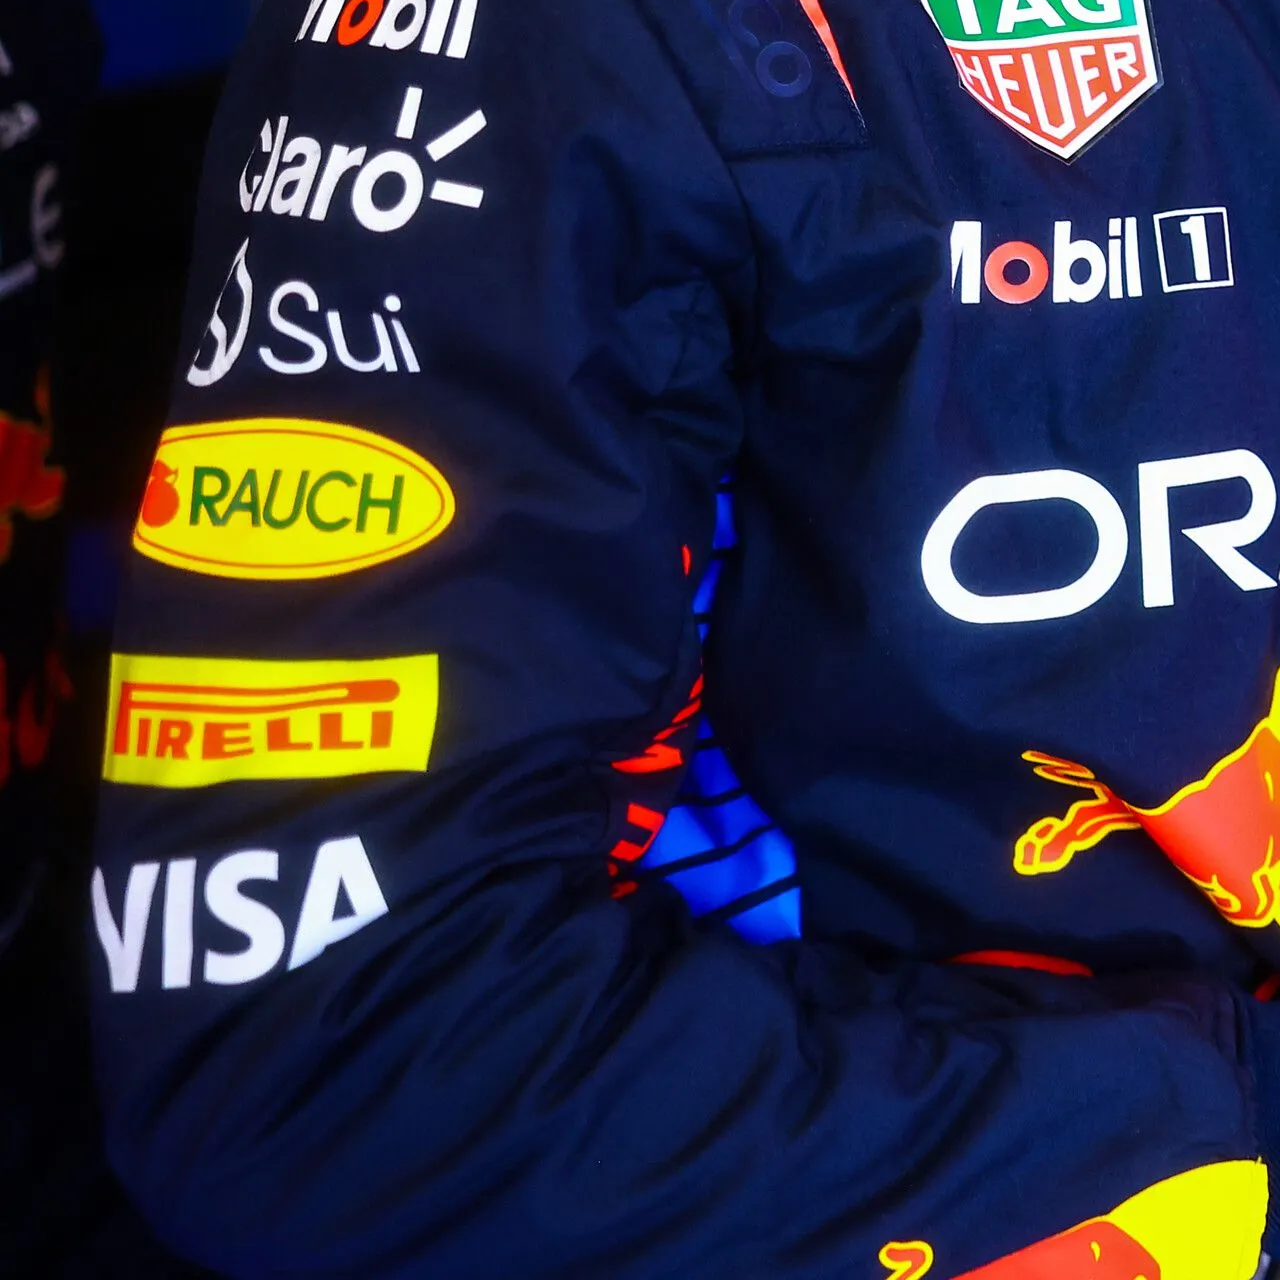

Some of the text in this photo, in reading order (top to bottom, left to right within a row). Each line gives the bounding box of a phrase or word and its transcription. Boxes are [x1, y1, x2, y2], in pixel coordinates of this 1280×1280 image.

[954, 42, 1141, 142] HEUER
[950, 214, 1212, 304] Mobil 1
[259, 279, 421, 376] Sui
[188, 466, 405, 536] RAUCH
[113, 678, 400, 760] PIRELLI
[91, 835, 390, 995] VISA
